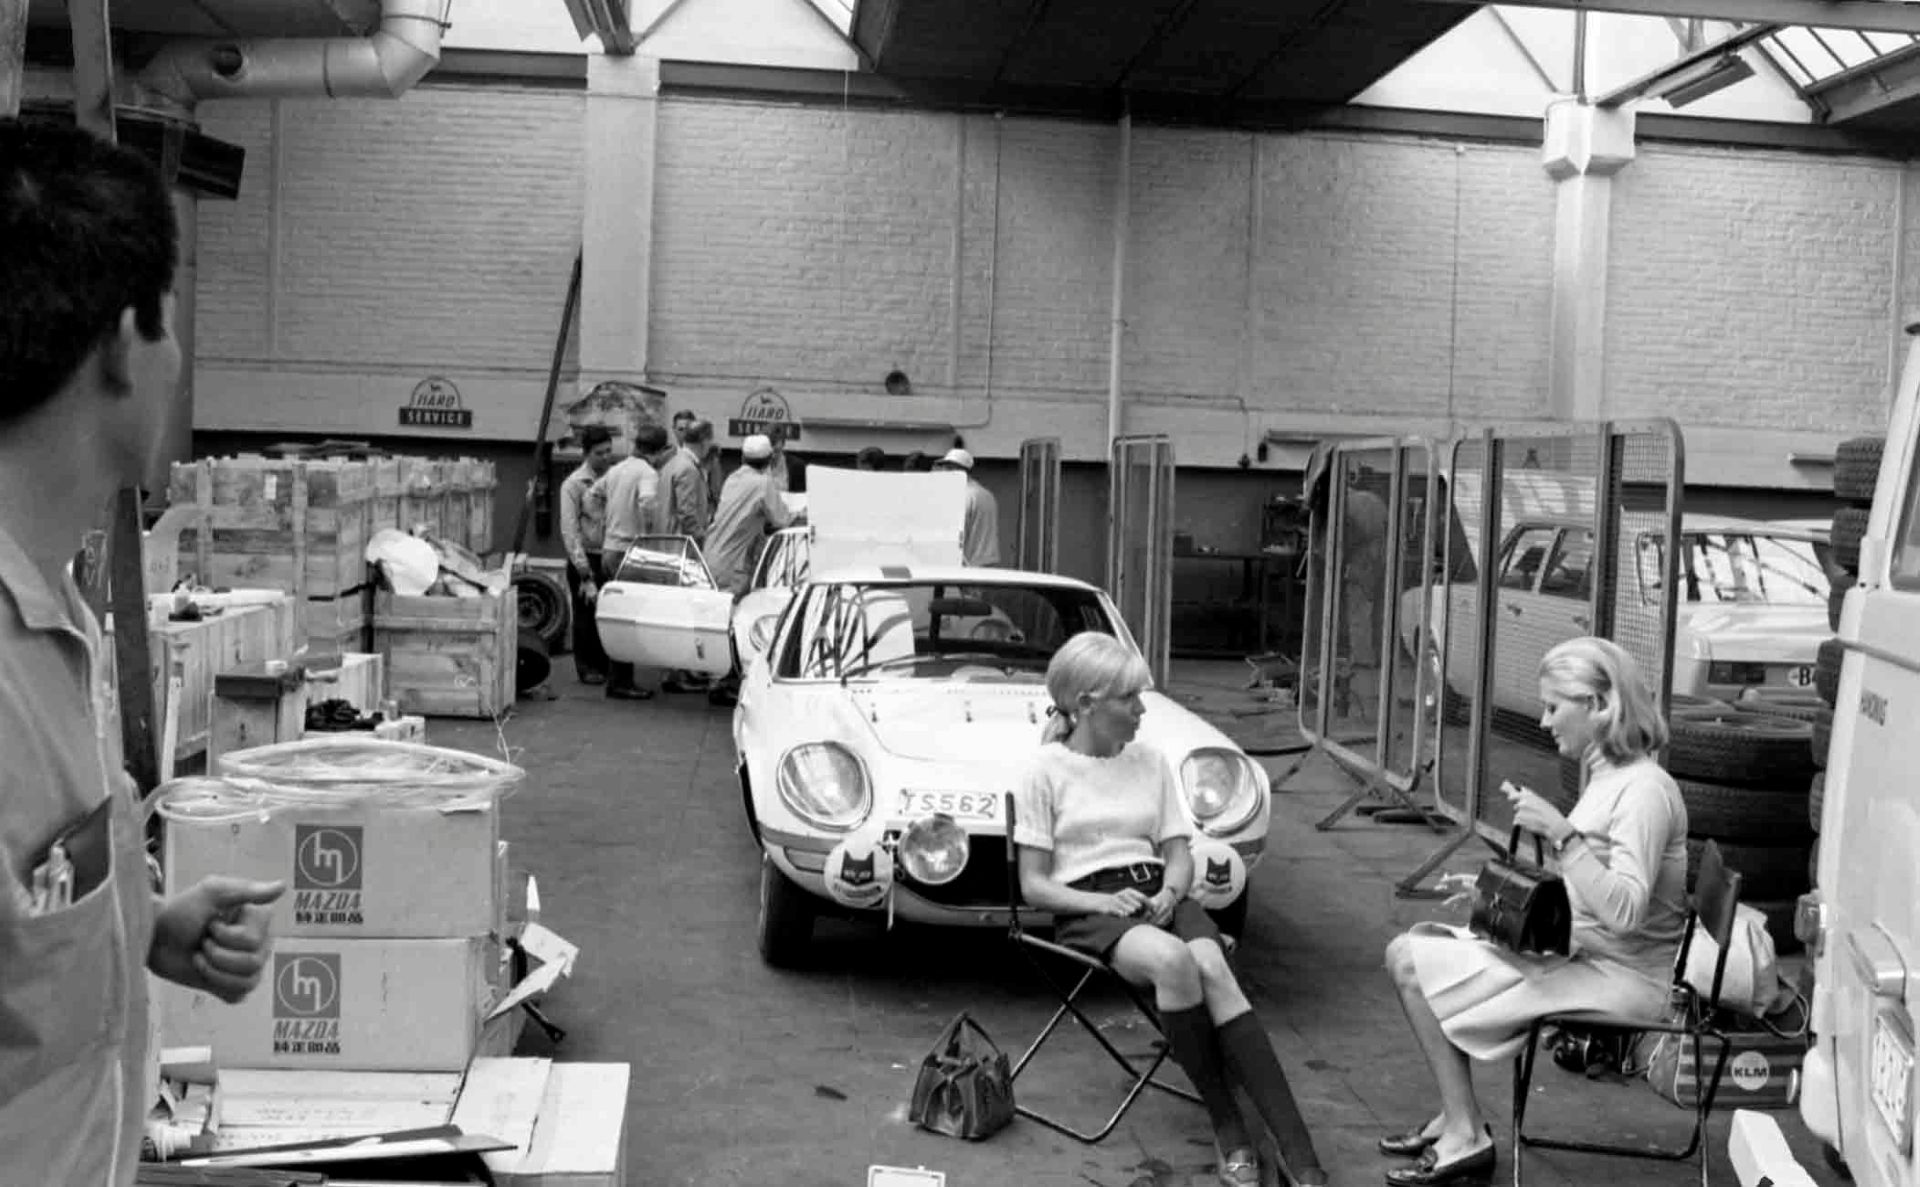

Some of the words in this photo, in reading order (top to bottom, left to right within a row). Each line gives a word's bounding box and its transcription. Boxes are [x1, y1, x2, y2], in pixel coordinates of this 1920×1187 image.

[408, 410, 464, 425] SERVICE
[294, 891, 362, 910] MAZDA
[273, 1021, 340, 1040] MAZDA
[1734, 1066, 1767, 1077] KLM
